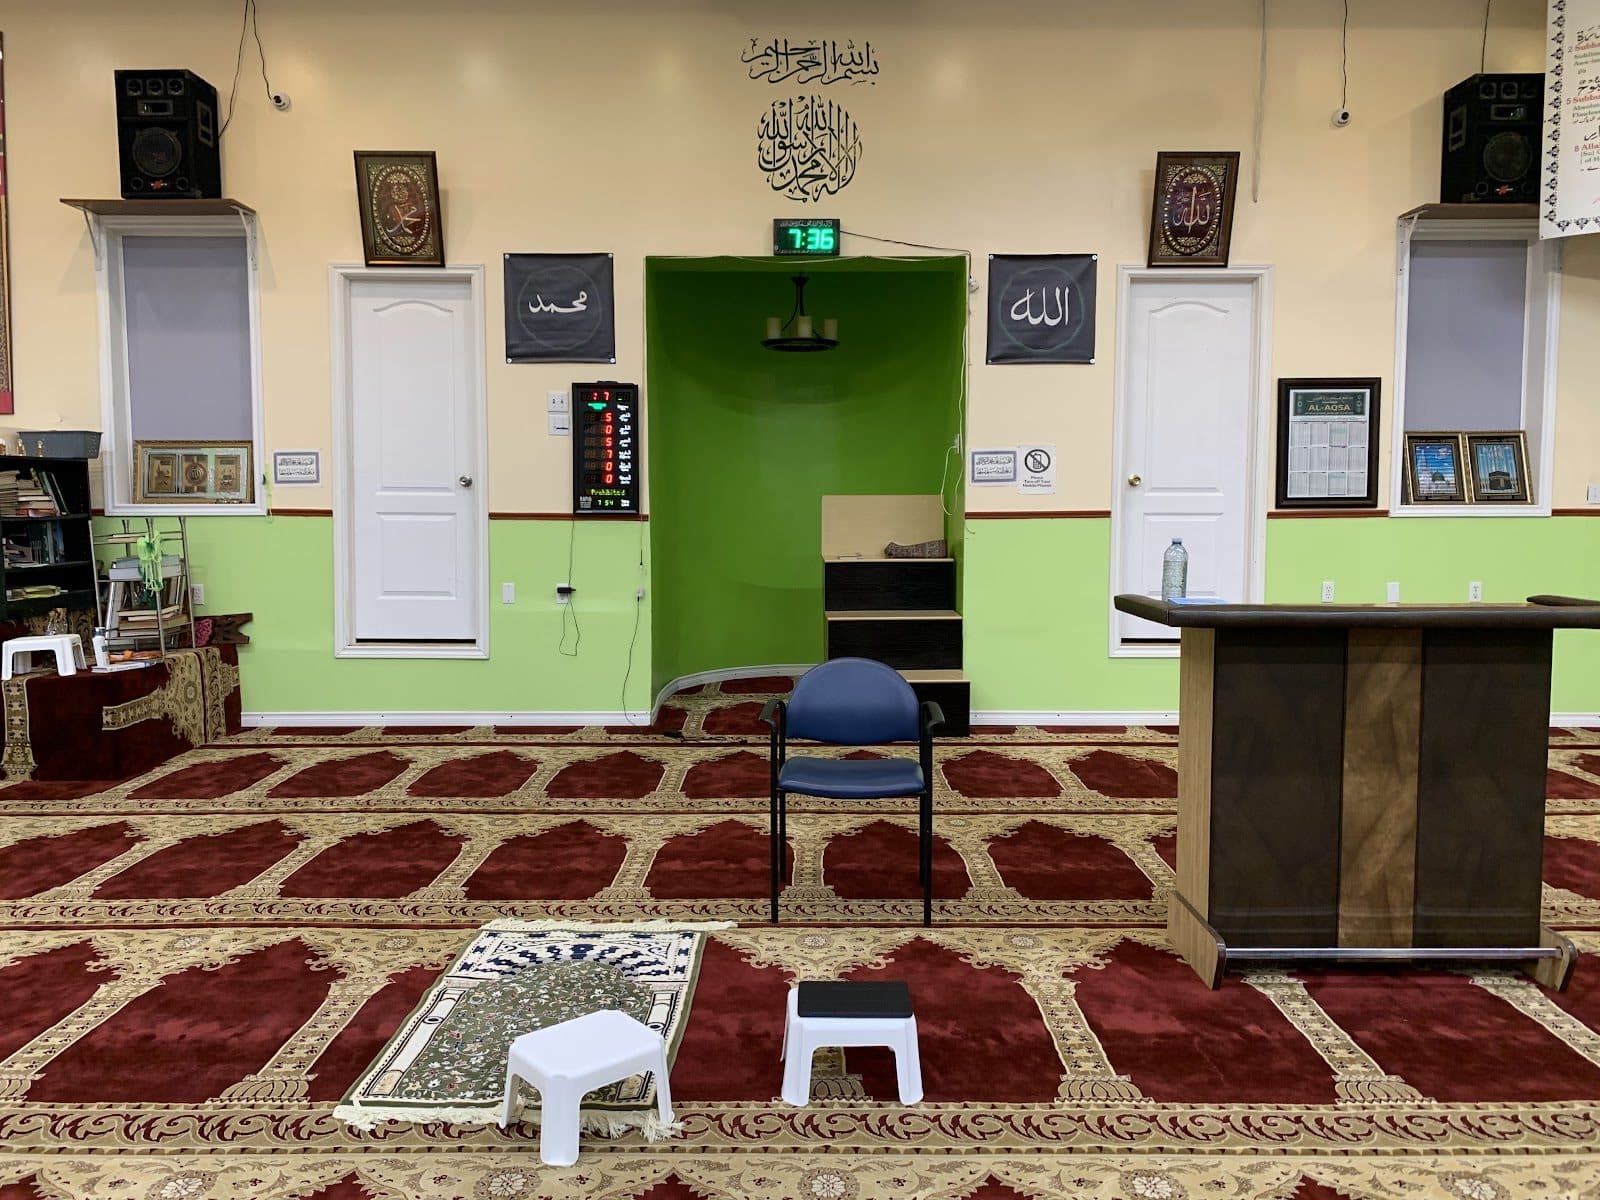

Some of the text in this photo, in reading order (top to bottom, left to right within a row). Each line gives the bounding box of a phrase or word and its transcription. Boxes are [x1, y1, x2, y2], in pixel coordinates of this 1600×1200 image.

[788, 228, 834, 250] 7:36
[528, 290, 588, 314] محمد
[1010, 286, 1070, 326] الله
[1308, 404, 1351, 412] AL-AQSA
